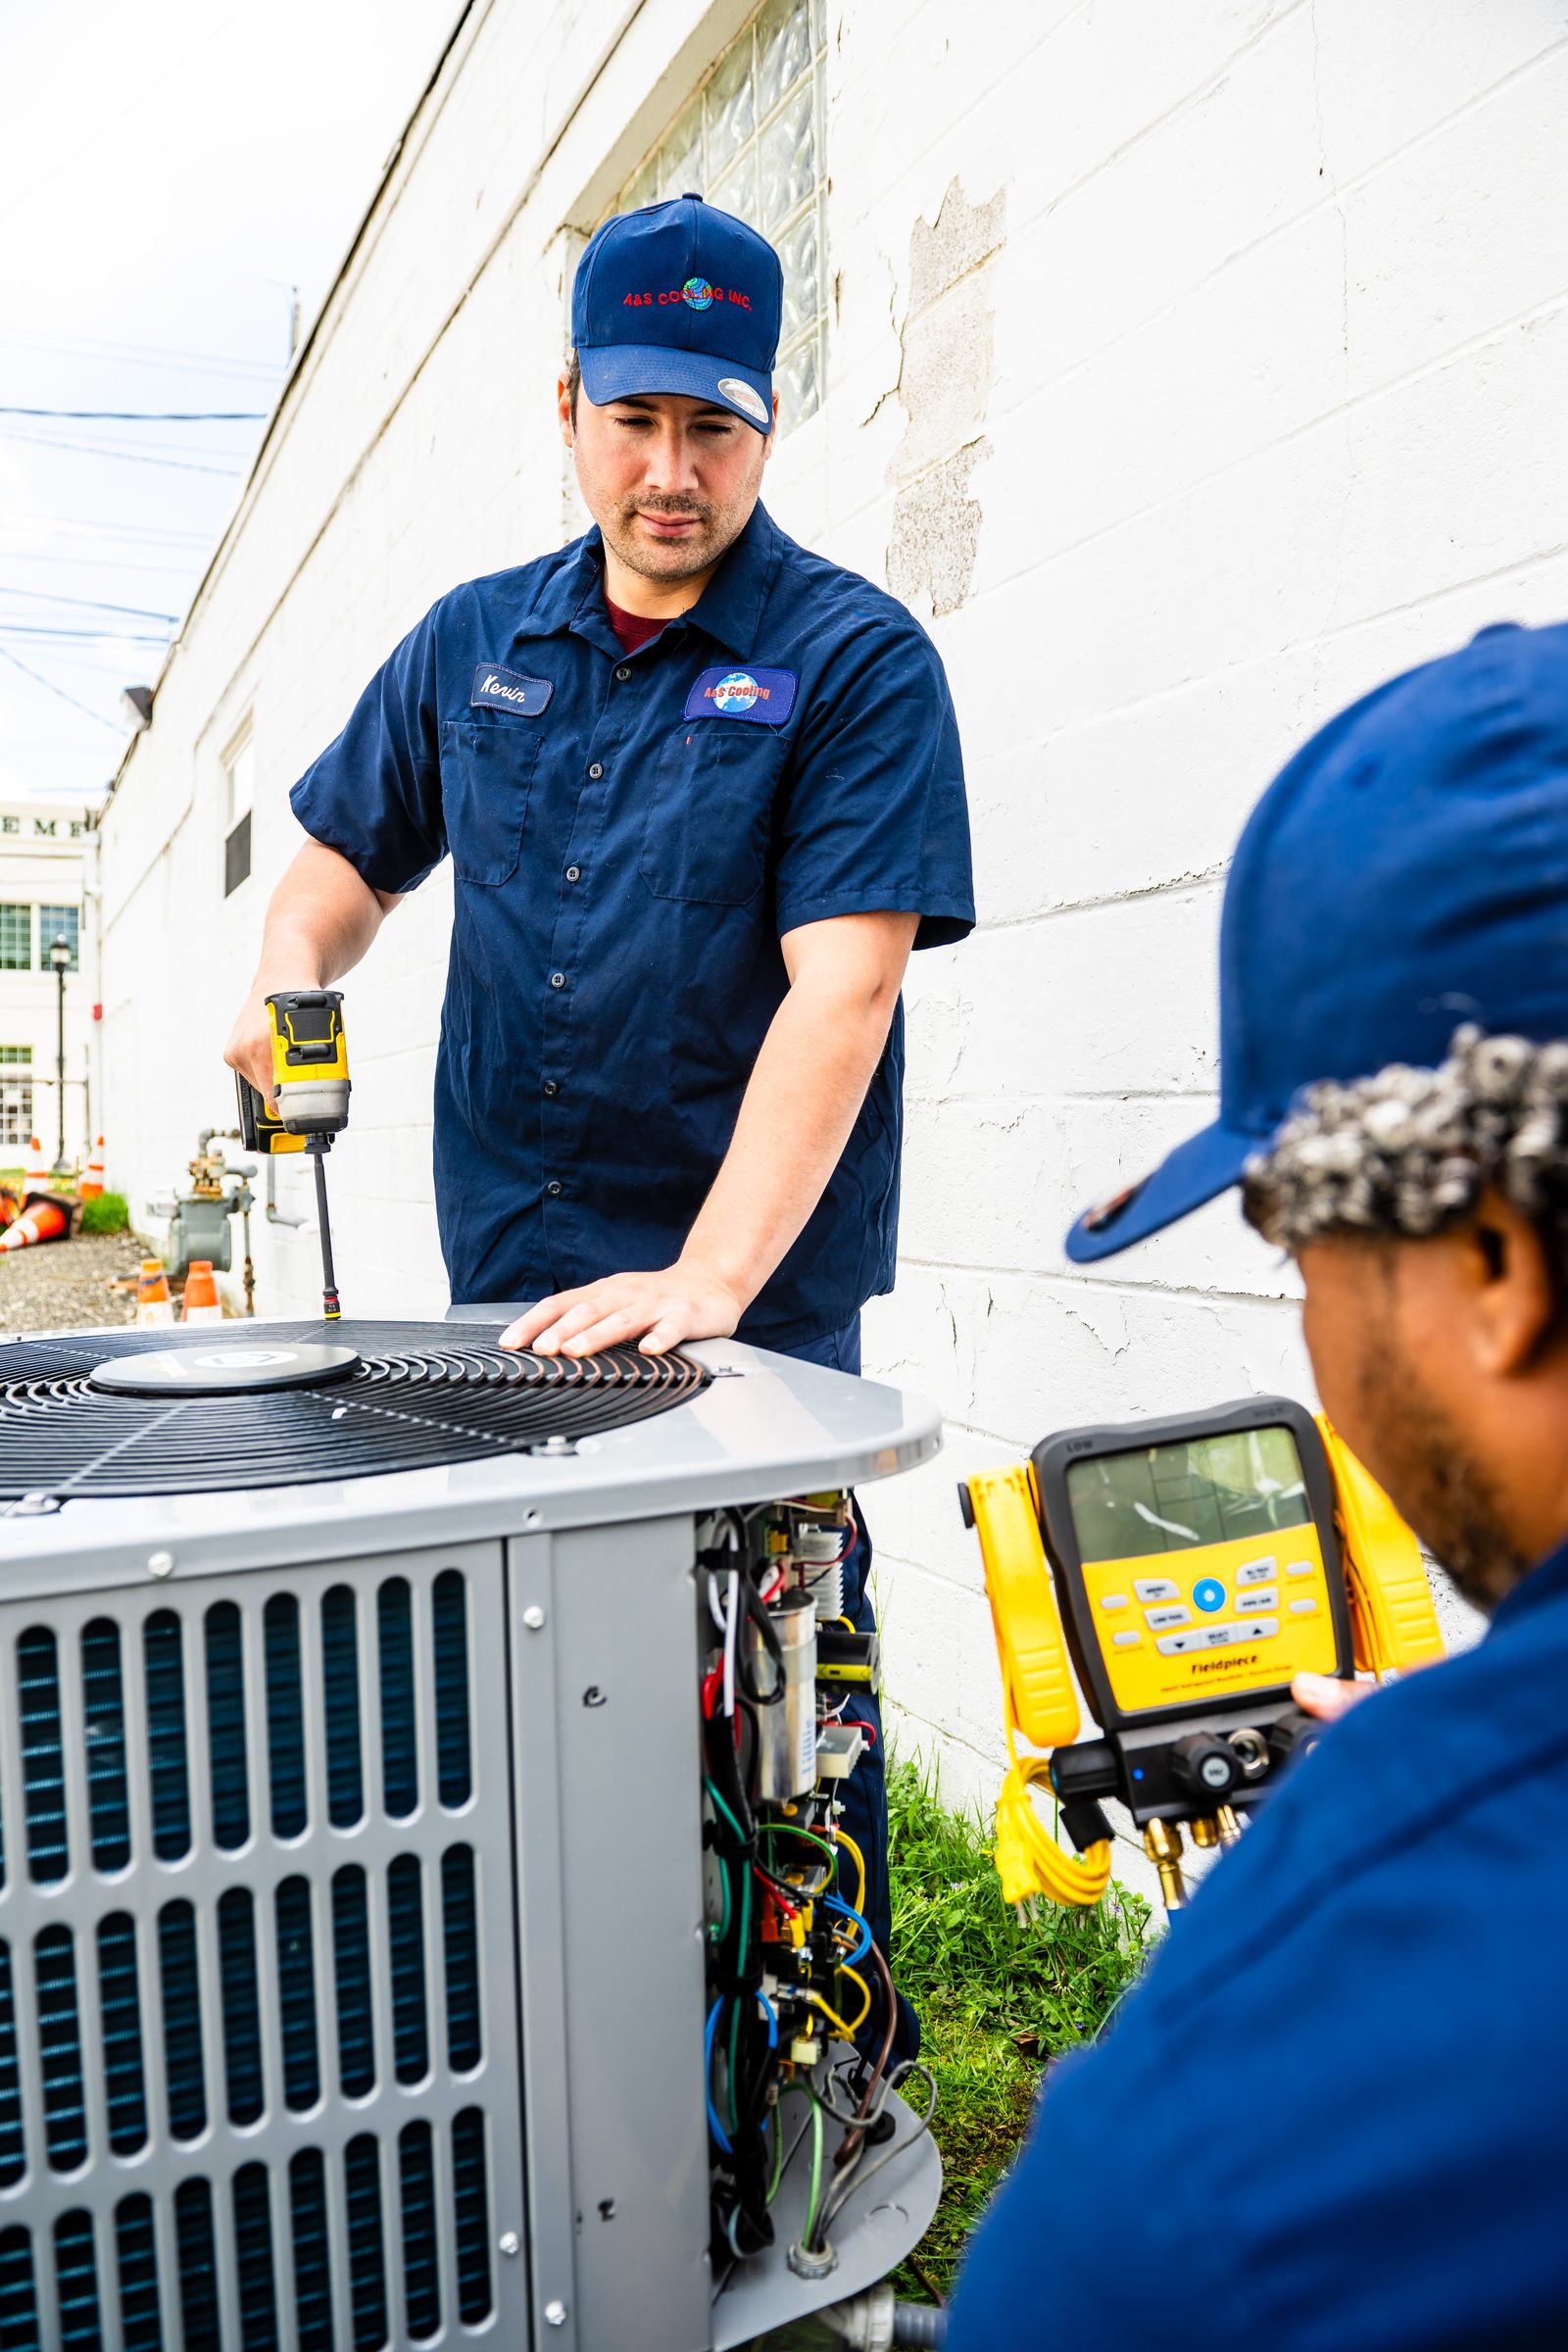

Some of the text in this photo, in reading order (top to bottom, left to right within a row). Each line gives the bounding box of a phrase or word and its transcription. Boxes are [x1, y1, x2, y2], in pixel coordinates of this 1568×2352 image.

[623, 287, 753, 312] A&S COOLING INC.
[479, 674, 525, 703] Kevin
[726, 684, 770, 701] Cooling
[1192, 1655, 1258, 1675] Fieldpiece
